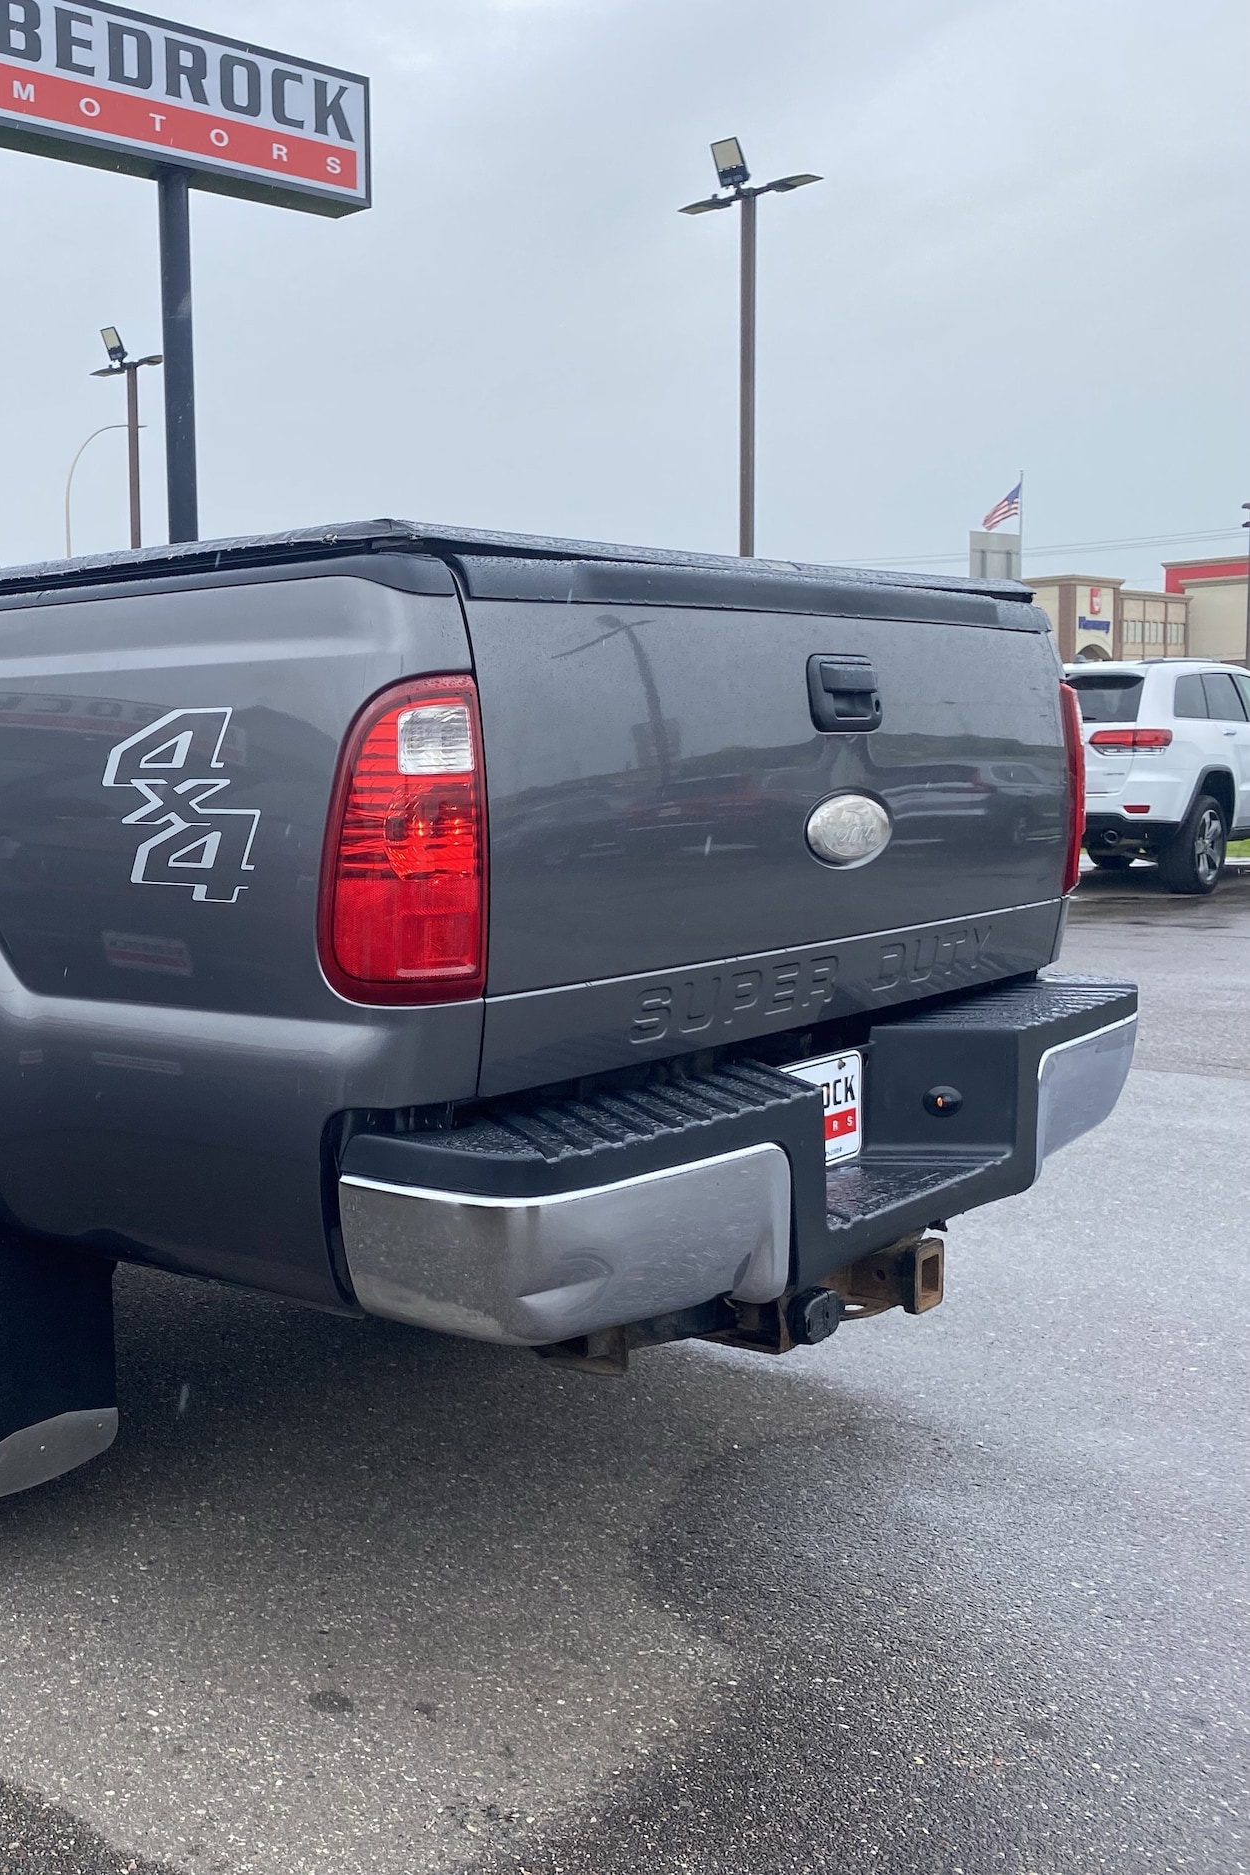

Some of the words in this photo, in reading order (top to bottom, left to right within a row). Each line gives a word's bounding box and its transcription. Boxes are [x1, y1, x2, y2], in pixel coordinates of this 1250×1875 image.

[12, 80, 342, 175] MOTORS
[630, 955, 840, 1044] SUPER
[872, 924, 993, 992] DUTY
[821, 1074, 856, 1109] OCK
